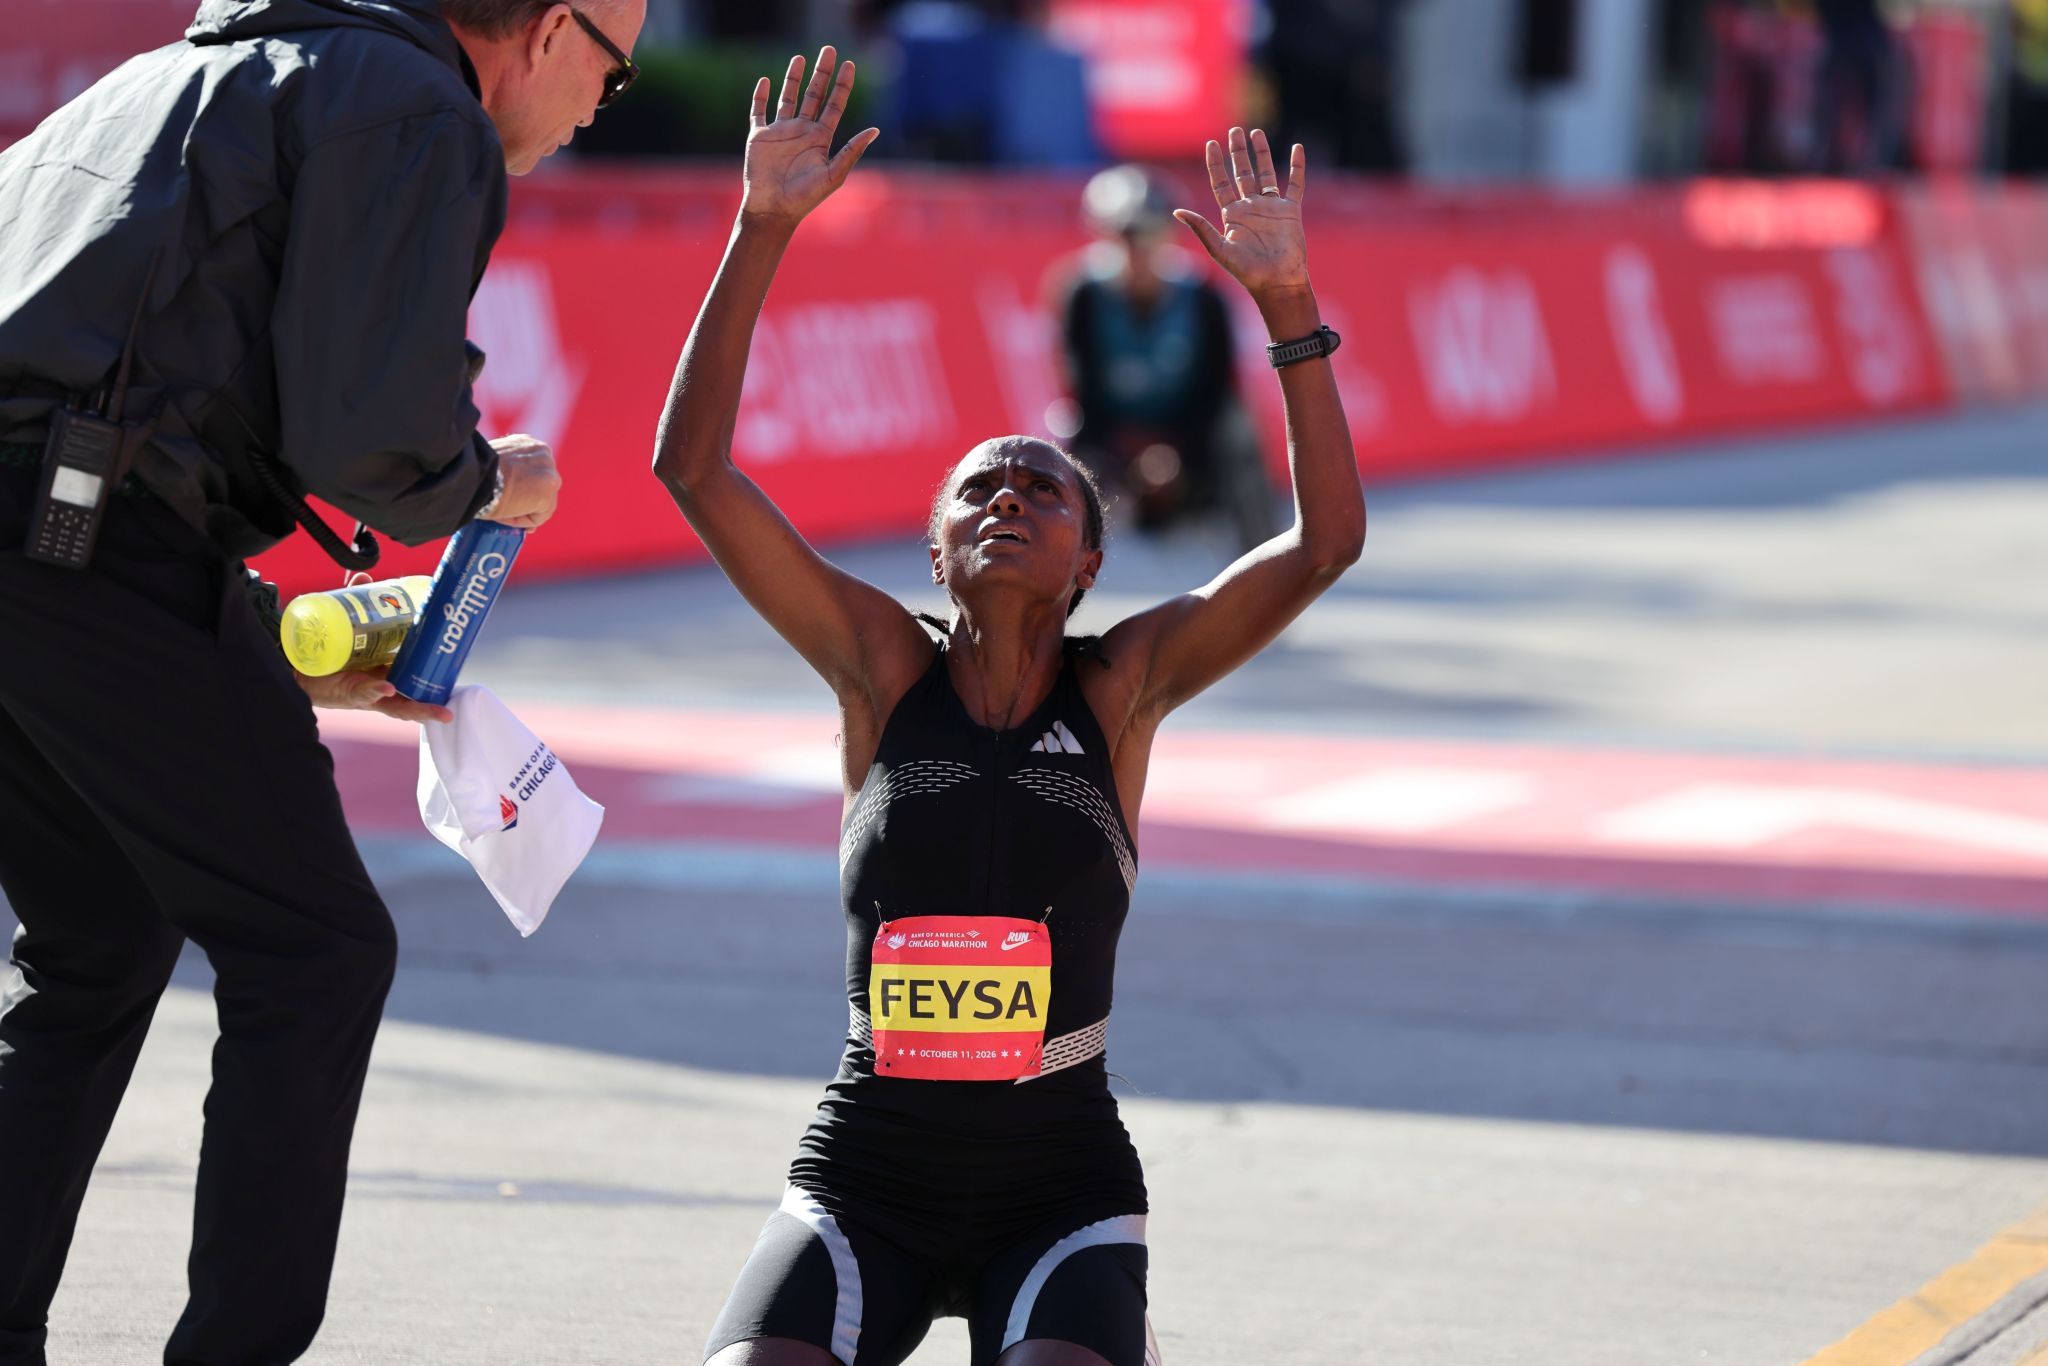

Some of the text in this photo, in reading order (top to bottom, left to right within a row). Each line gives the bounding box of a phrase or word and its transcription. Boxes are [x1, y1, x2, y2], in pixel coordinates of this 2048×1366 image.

[368, 586, 412, 618] G
[439, 552, 506, 654] Culligan
[509, 761, 533, 789] BANK
[530, 750, 541, 763] OF
[518, 754, 556, 802] CHICAGO
[908, 940, 988, 949] CHICAGO MARATHON
[1007, 931, 1030, 942] RUN
[881, 978, 1038, 1020] FEYSA
[920, 1049, 997, 1059] OCTOBER 11, 2026
